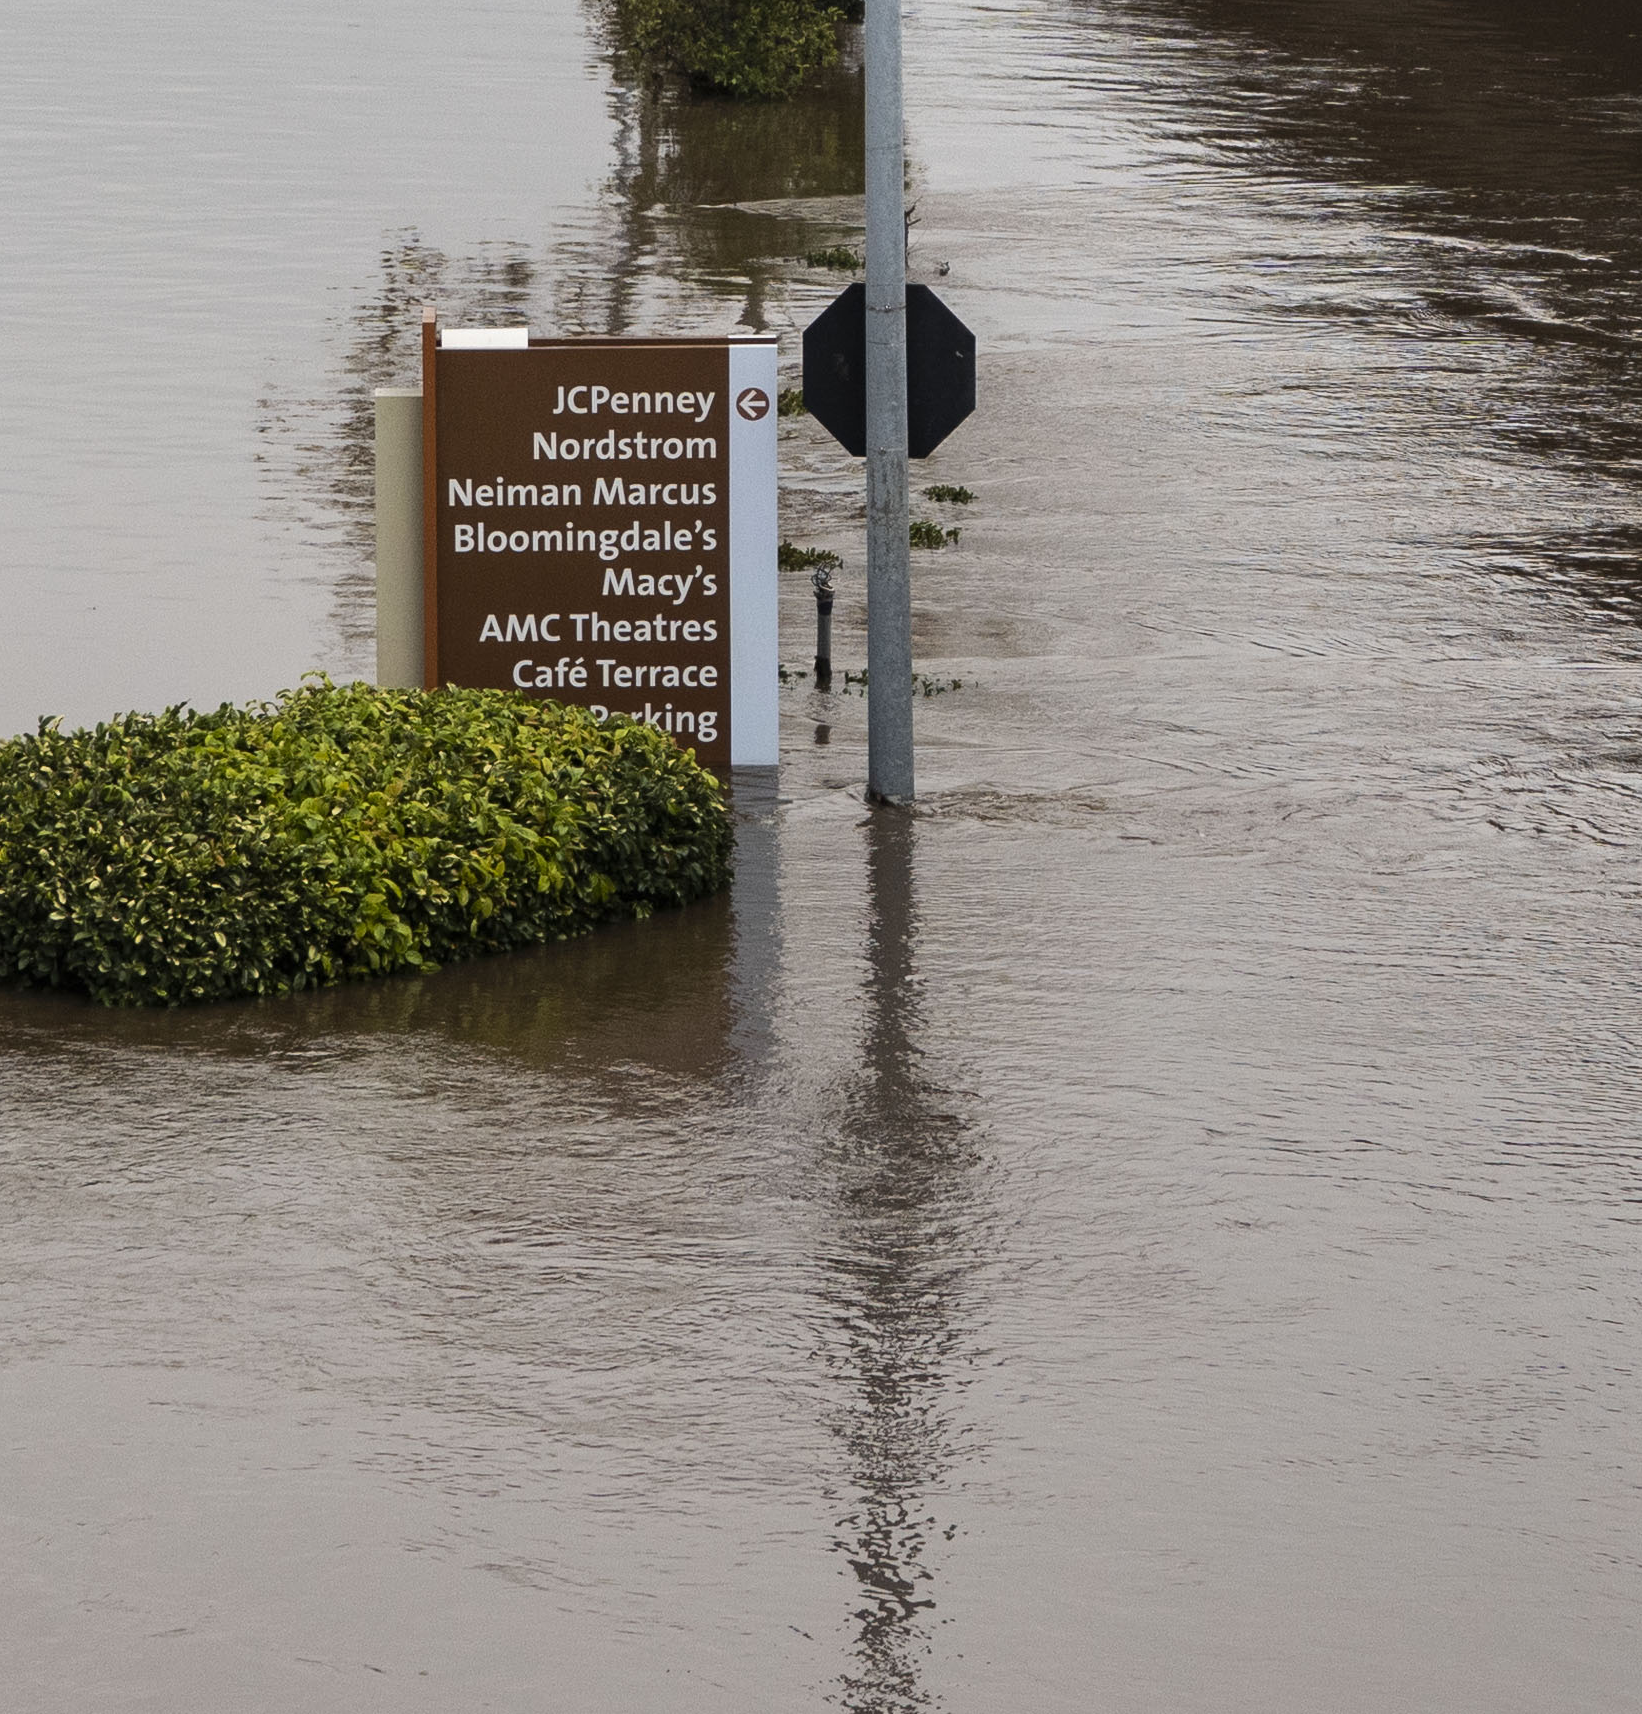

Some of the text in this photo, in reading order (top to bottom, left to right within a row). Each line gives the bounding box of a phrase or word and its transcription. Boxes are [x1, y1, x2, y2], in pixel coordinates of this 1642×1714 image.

[553, 385, 716, 423] JCPenney
[533, 429, 717, 460] Nordstrom
[448, 477, 717, 507] Neiman Marcus
[454, 519, 718, 561] Bloomingdale’s
[602, 564, 718, 605] Macy’s
[479, 611, 718, 642] AMC Theatres
[512, 656, 718, 688] Café Terrace
[590, 703, 718, 743] Prking
